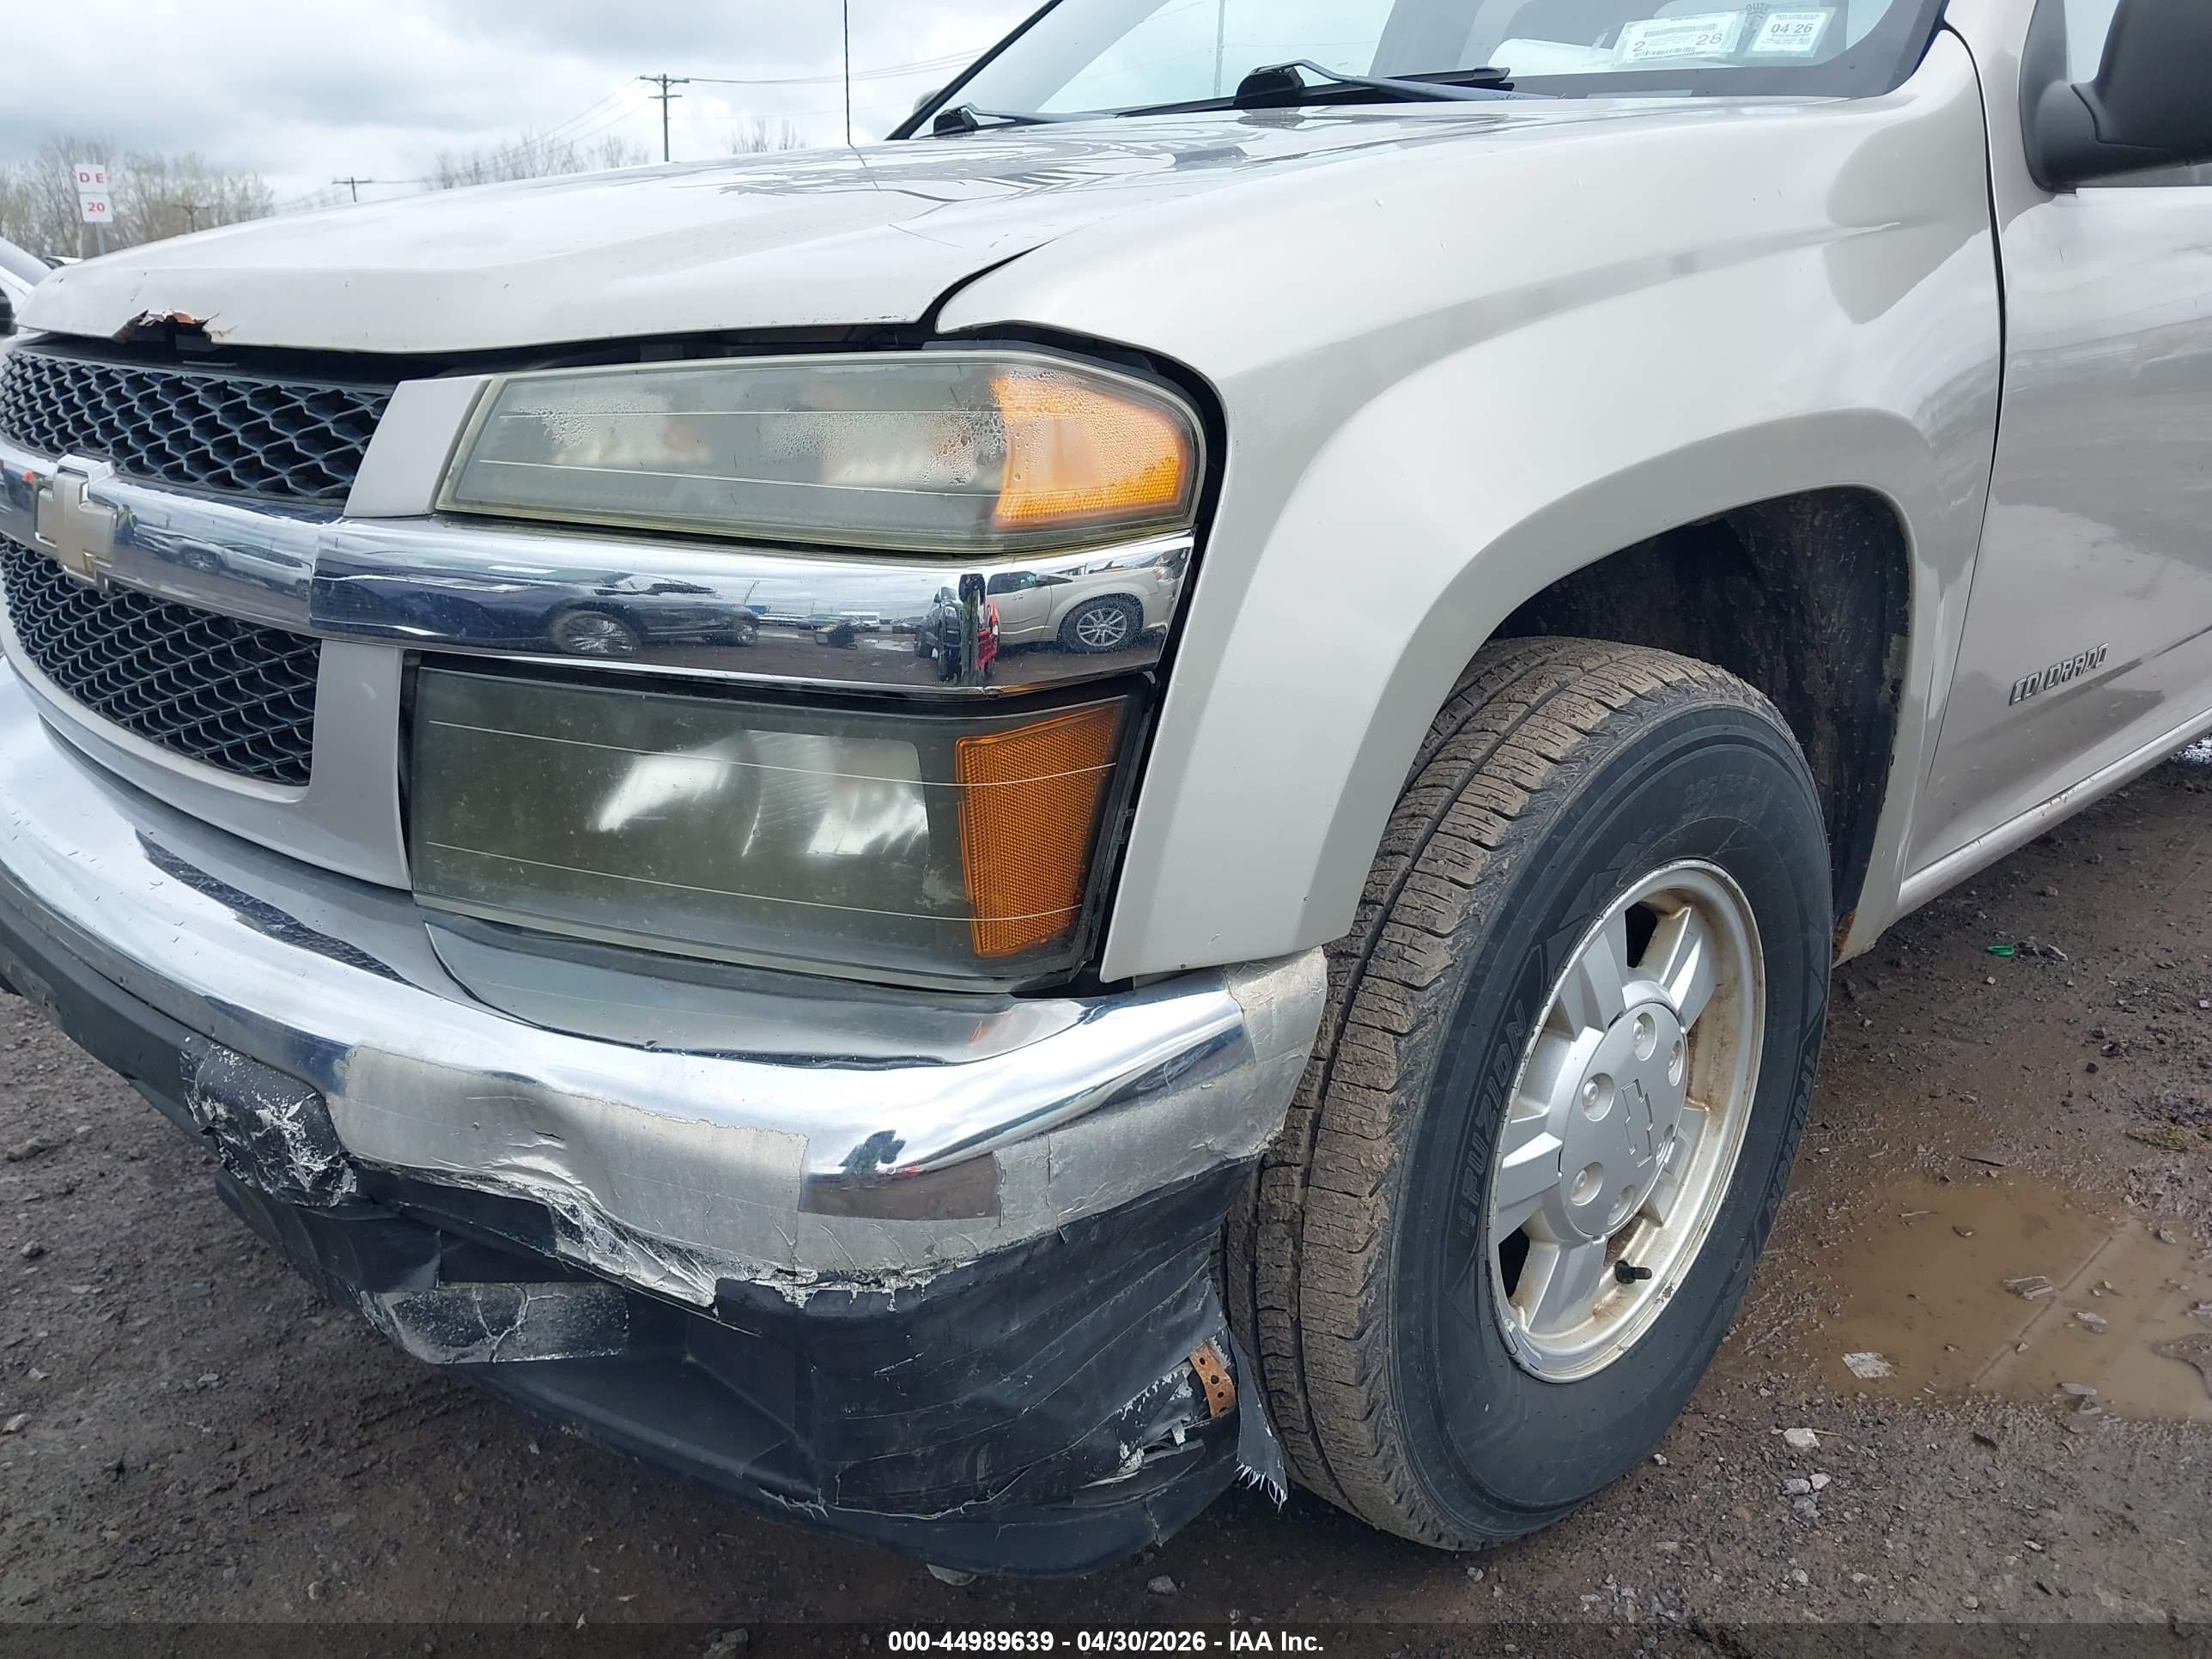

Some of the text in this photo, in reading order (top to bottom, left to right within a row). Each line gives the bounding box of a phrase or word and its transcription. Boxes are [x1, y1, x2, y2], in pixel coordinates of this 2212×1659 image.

[1771, 23, 1814, 33] 04 26
[1632, 33, 1723, 52] 2 28
[79, 172, 105, 183] D E
[87, 202, 105, 212] 20
[2008, 642, 2109, 706] COLORADO
